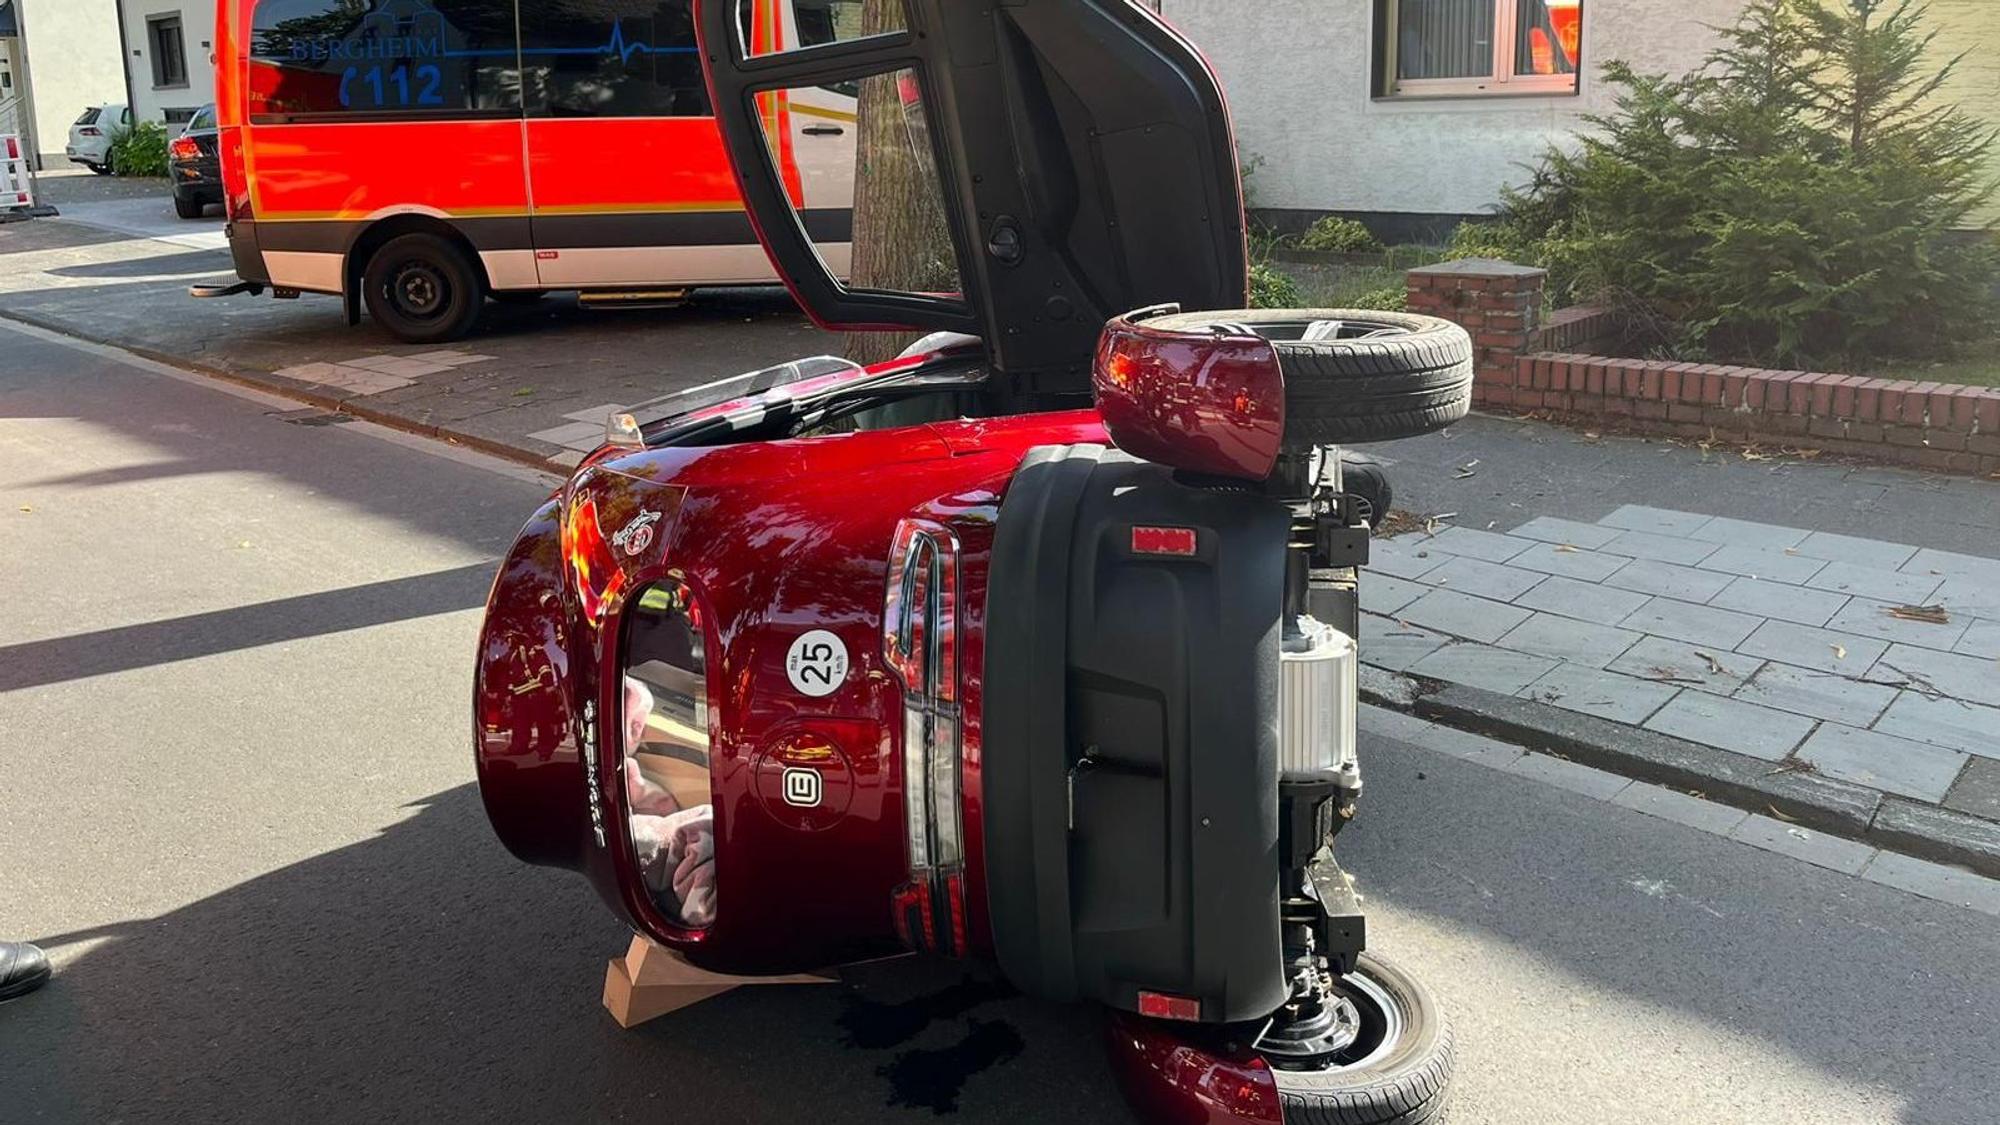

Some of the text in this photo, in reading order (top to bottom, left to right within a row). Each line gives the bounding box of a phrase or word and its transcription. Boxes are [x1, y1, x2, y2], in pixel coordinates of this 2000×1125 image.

[291, 36, 438, 60] BERGHEIM
[364, 63, 444, 107] 112
[801, 643, 833, 685] 25
